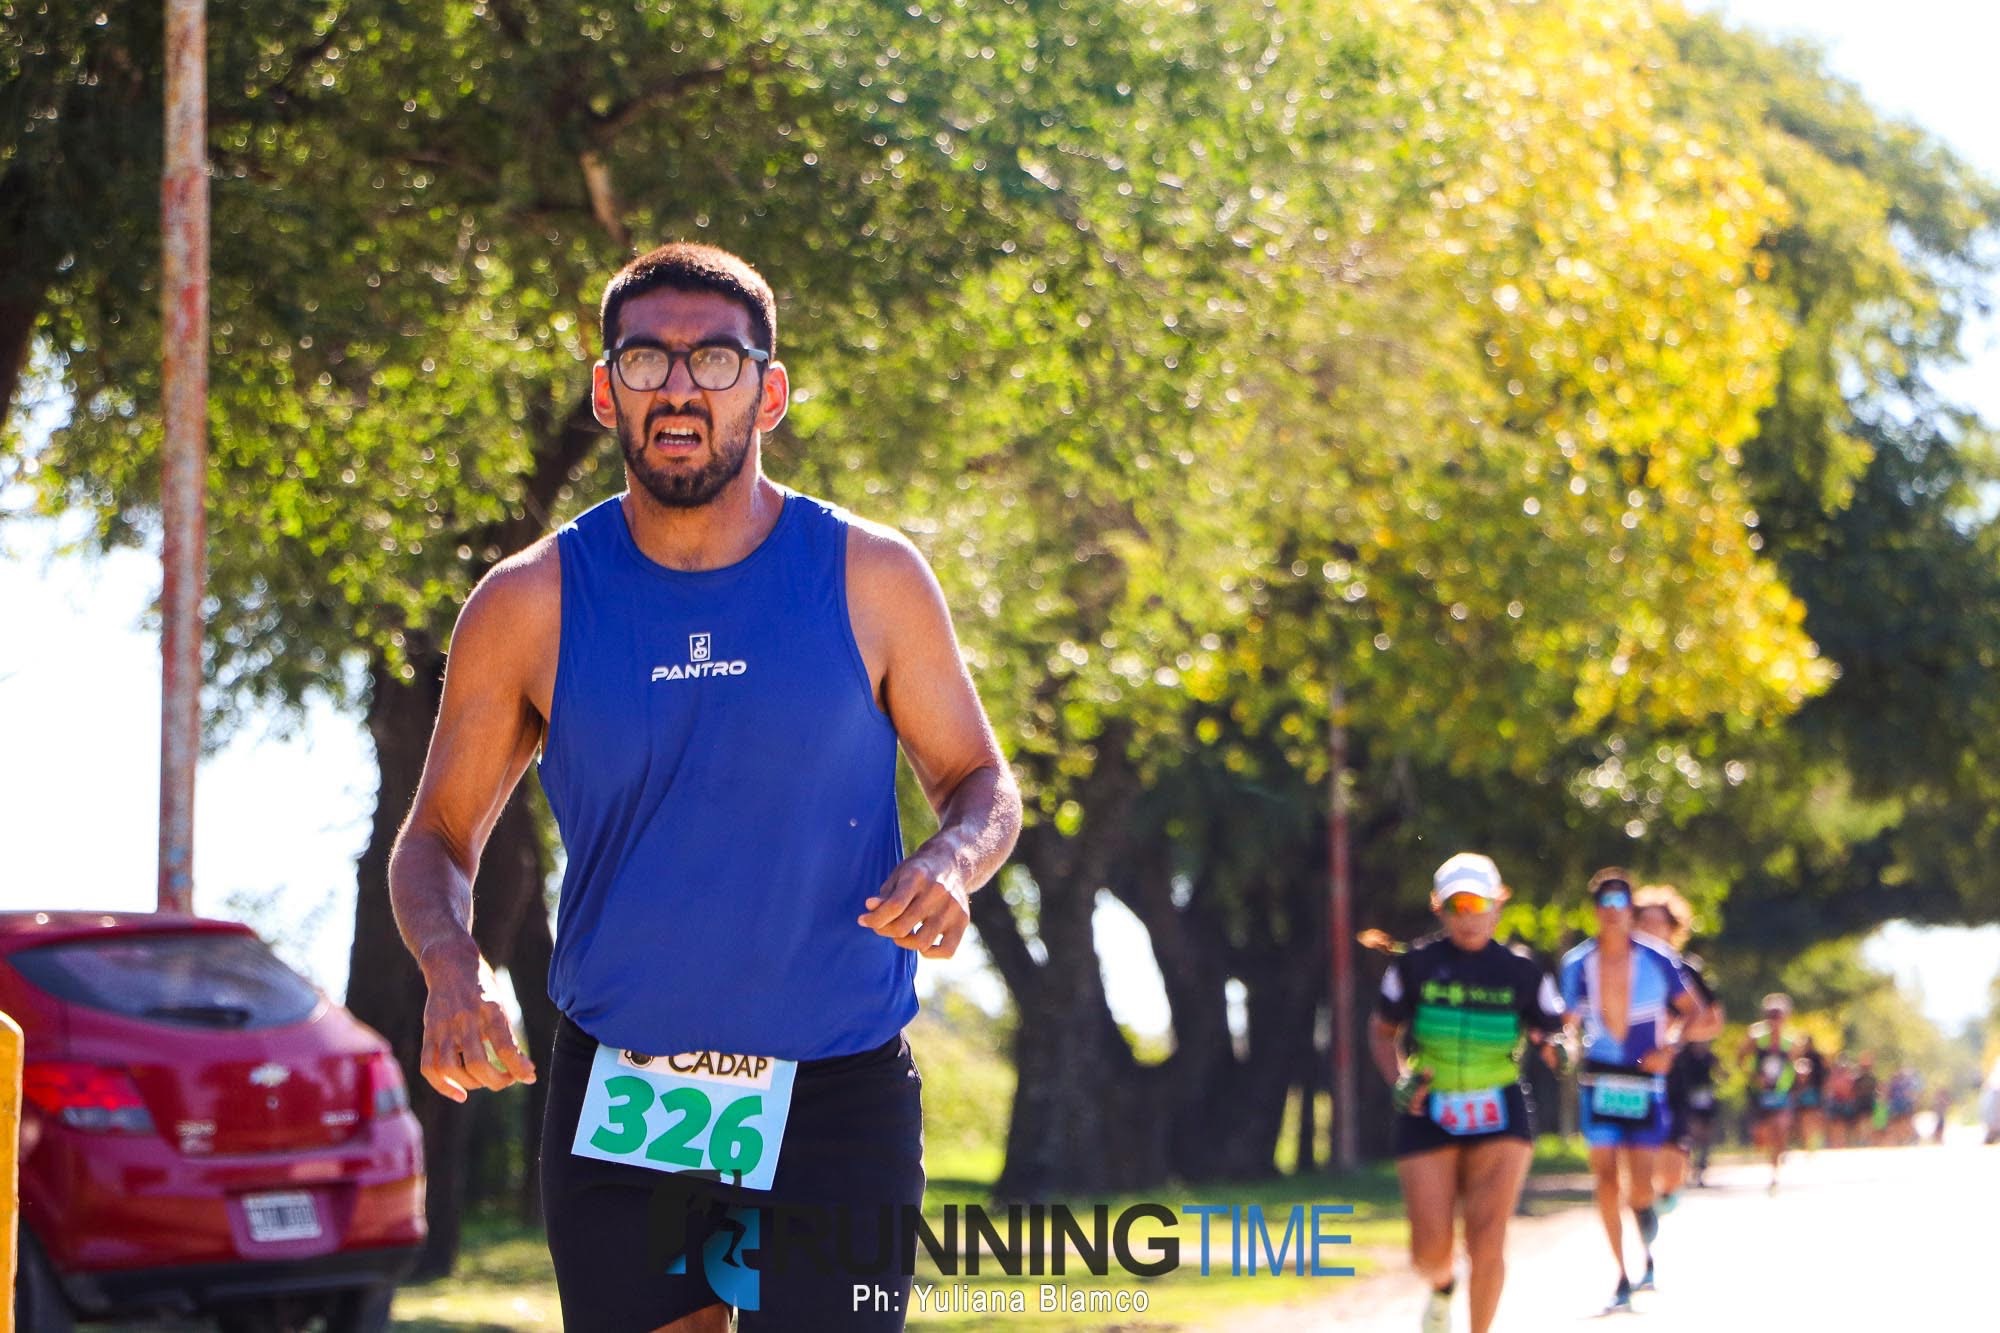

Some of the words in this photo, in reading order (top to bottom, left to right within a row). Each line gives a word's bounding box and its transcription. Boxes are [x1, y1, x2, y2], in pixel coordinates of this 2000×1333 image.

[651, 660, 747, 682] PANTRO
[668, 1051, 768, 1078] CADAP
[590, 1075, 764, 1177] 326
